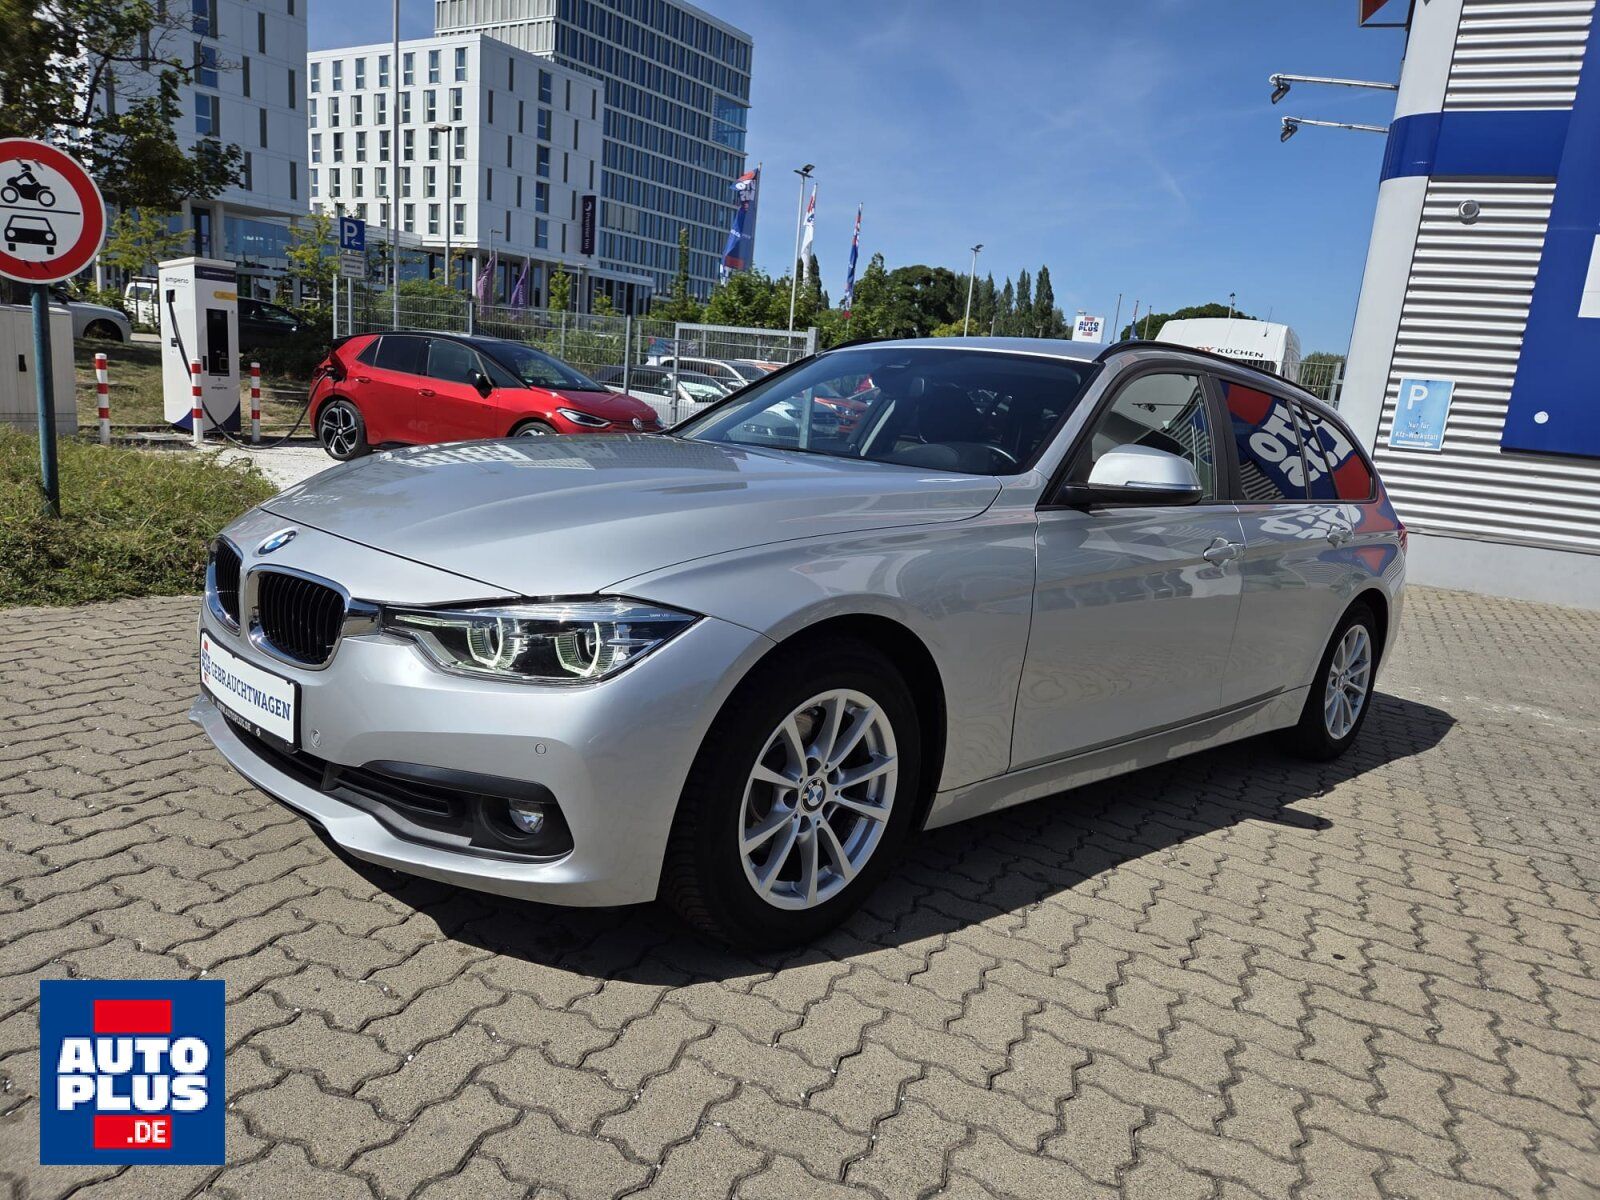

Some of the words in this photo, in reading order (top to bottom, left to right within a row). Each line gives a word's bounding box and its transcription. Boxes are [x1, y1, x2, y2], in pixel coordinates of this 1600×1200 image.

[343, 221, 358, 245] P
[1217, 348, 1264, 358] KÜCHEN
[1407, 384, 1428, 410] P
[1395, 431, 1438, 441] Kfz-Werkstatt
[211, 661, 291, 721] GEBRAUCHTWAGEN
